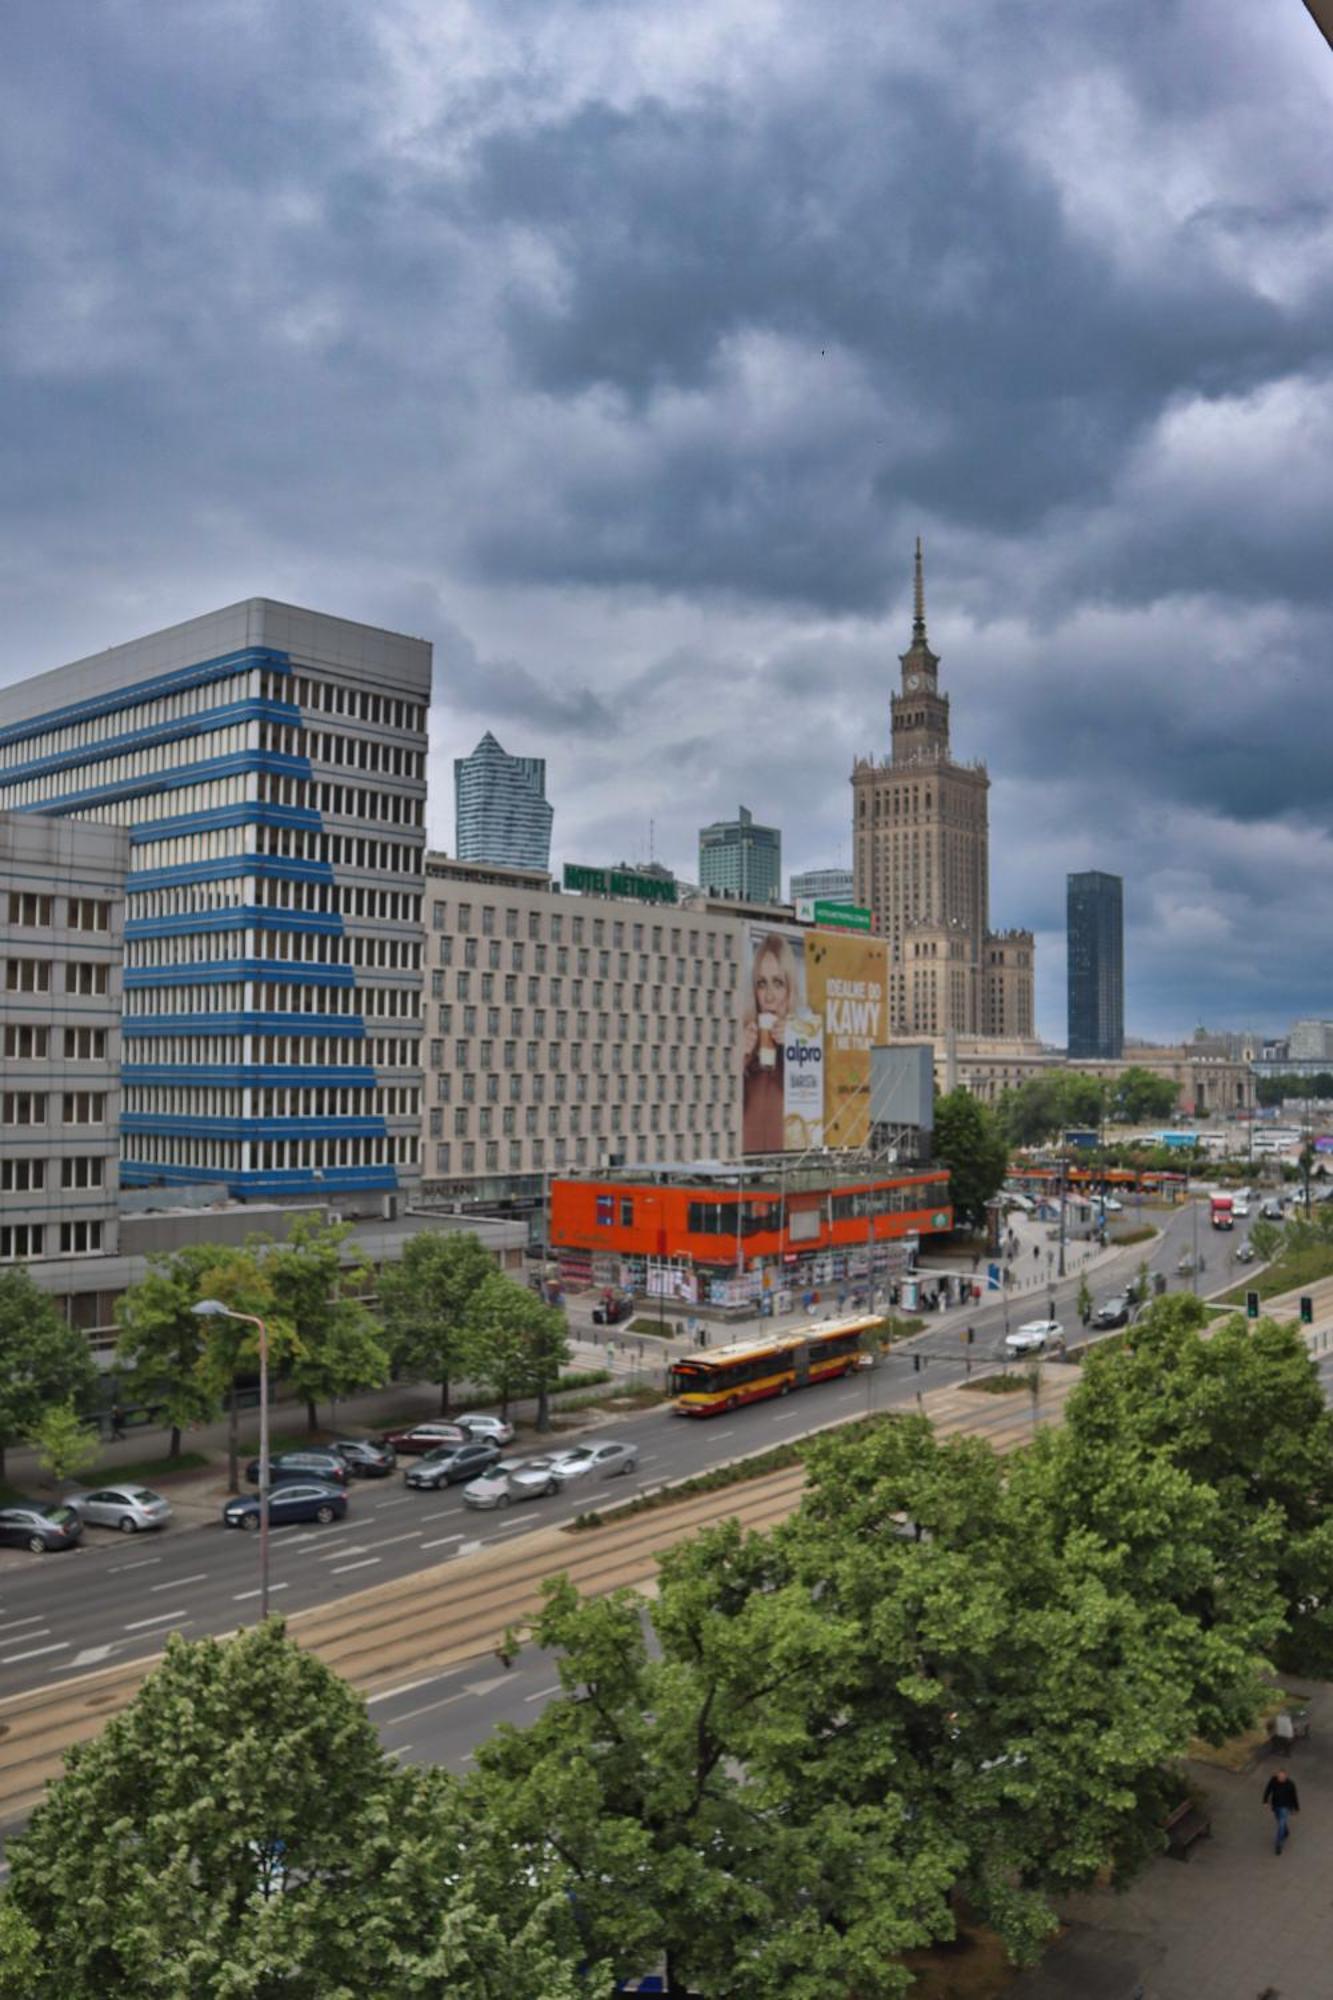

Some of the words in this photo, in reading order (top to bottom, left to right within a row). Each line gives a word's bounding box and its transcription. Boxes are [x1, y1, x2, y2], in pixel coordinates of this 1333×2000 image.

[564, 865, 606, 892] HOTEL
[610, 871, 678, 903] METROPOL
[827, 999, 881, 1036] KAWY
[786, 1040, 822, 1066] alpro
